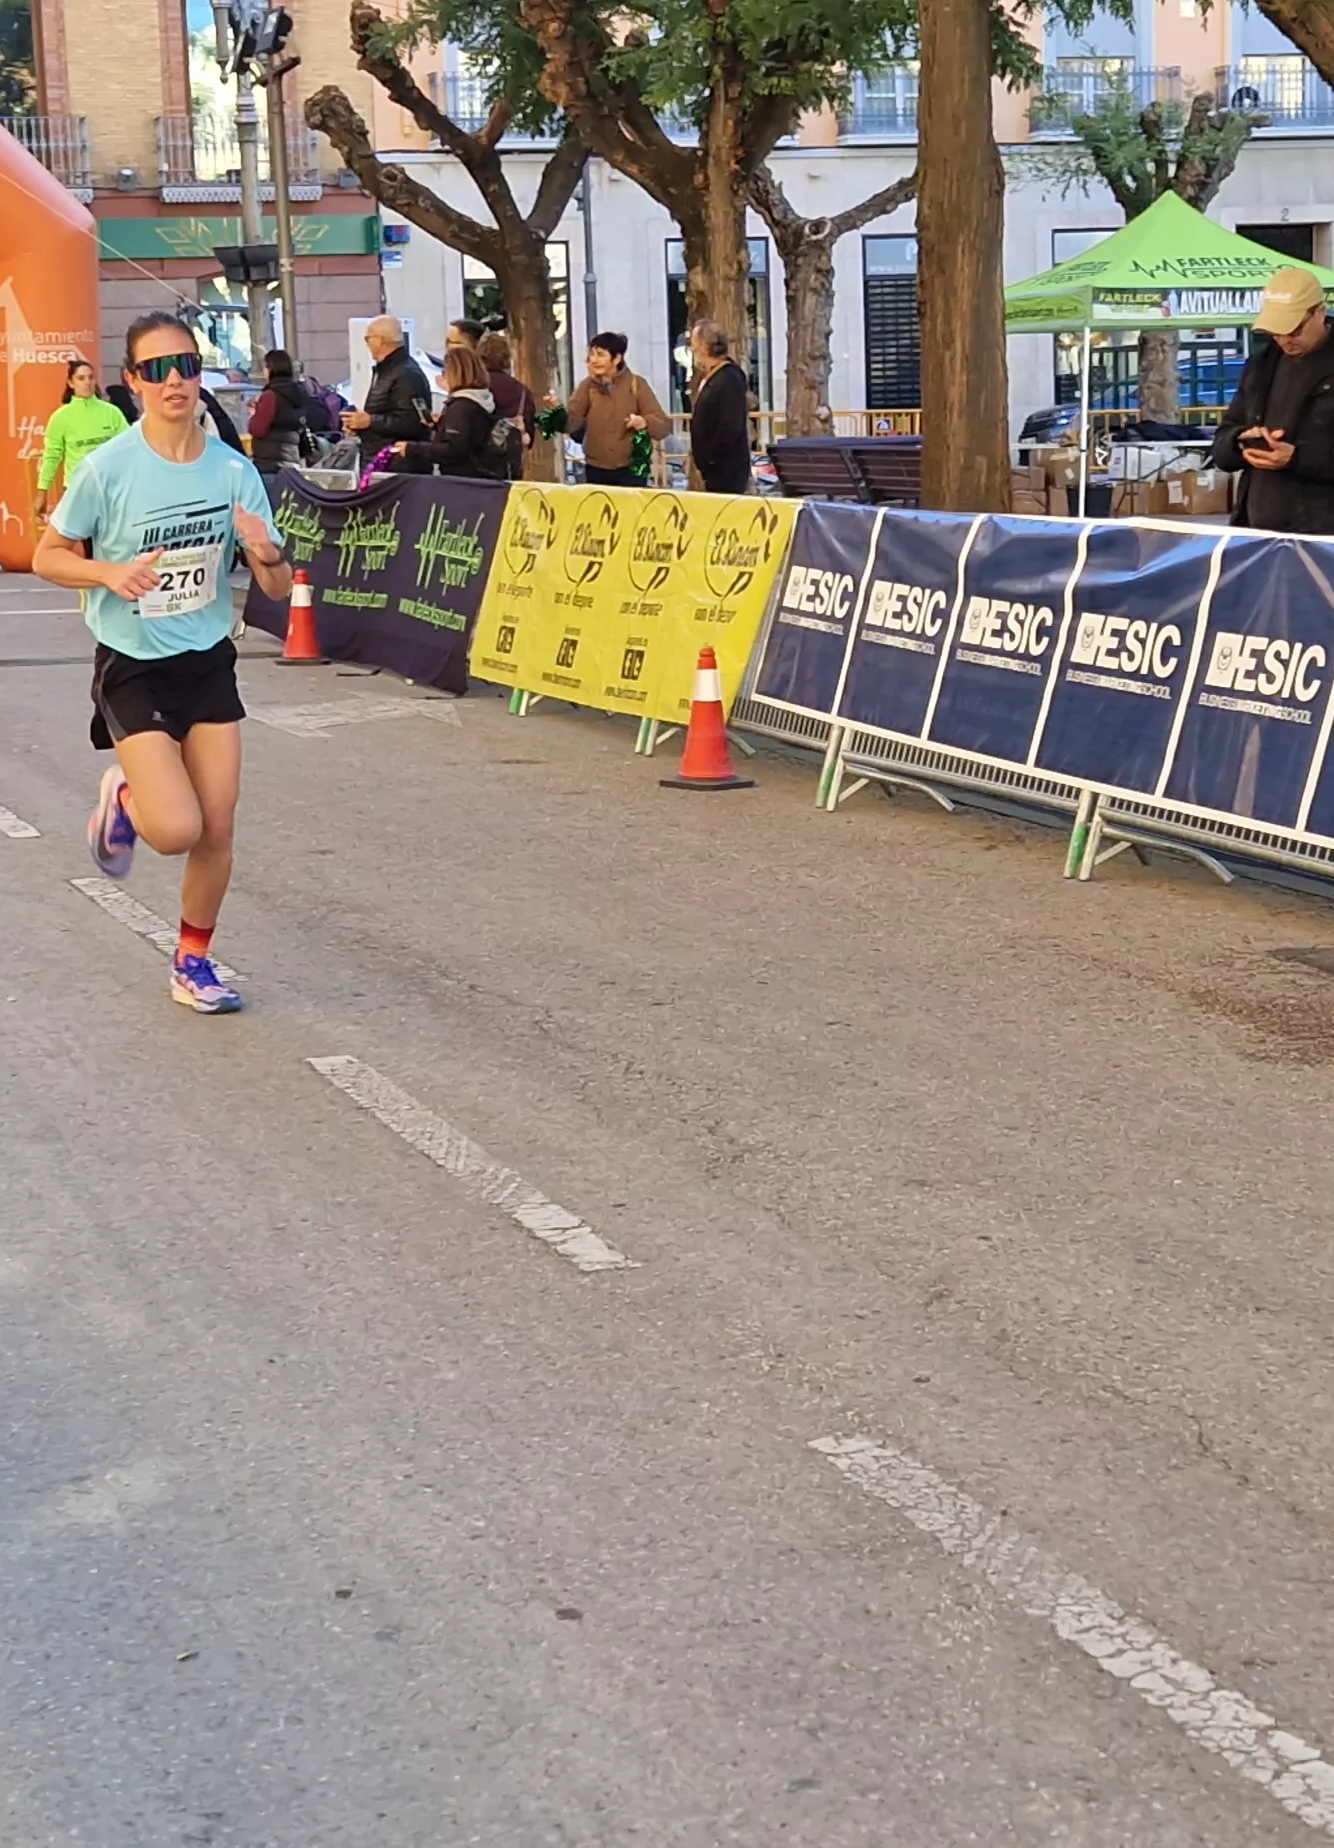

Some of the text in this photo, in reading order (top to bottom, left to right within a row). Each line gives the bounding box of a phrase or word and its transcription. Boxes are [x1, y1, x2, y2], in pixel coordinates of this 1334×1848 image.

[1279, 208, 1291, 222] 2
[1176, 256, 1273, 267] FARTLECK
[13, 349, 78, 364] Huesca
[142, 526, 161, 546] III
[163, 519, 213, 541] CARRERA
[159, 568, 206, 593] 270
[798, 568, 855, 619] ESIC
[168, 590, 201, 602] JULIA
[884, 582, 948, 637] ESIC
[981, 597, 1054, 657] ESIC
[1095, 616, 1182, 679] ESIC
[1233, 635, 1327, 702] ESIC
